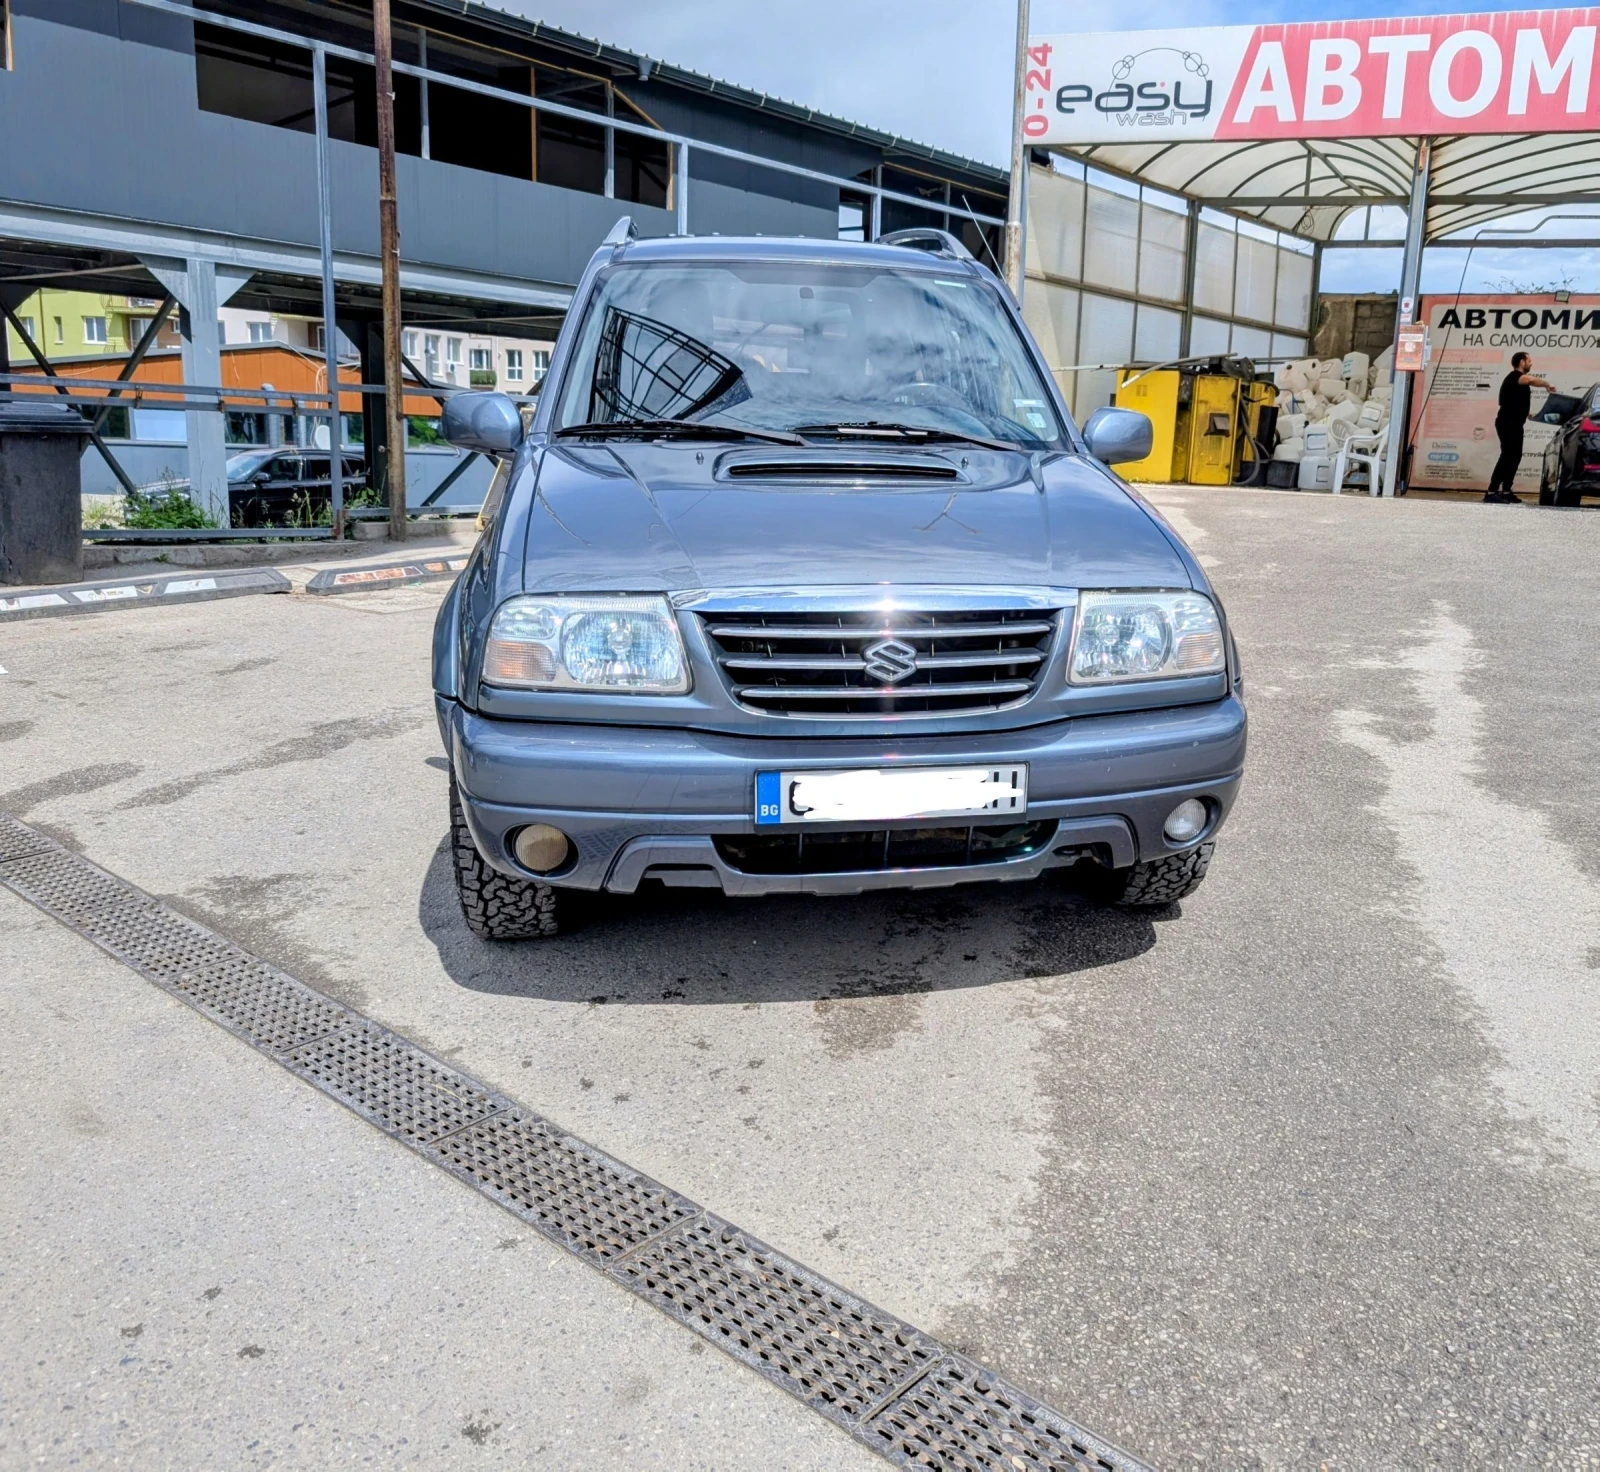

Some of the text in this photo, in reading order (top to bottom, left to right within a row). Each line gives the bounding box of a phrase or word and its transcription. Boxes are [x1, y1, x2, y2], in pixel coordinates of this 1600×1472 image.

[1232, 25, 1598, 123] АВТОМ
[1056, 80, 1213, 118] easy
[1116, 109, 1188, 127] wash
[1437, 308, 1600, 330] АВТОМИ
[1463, 333, 1484, 347] НА
[760, 804, 779, 817] BG
